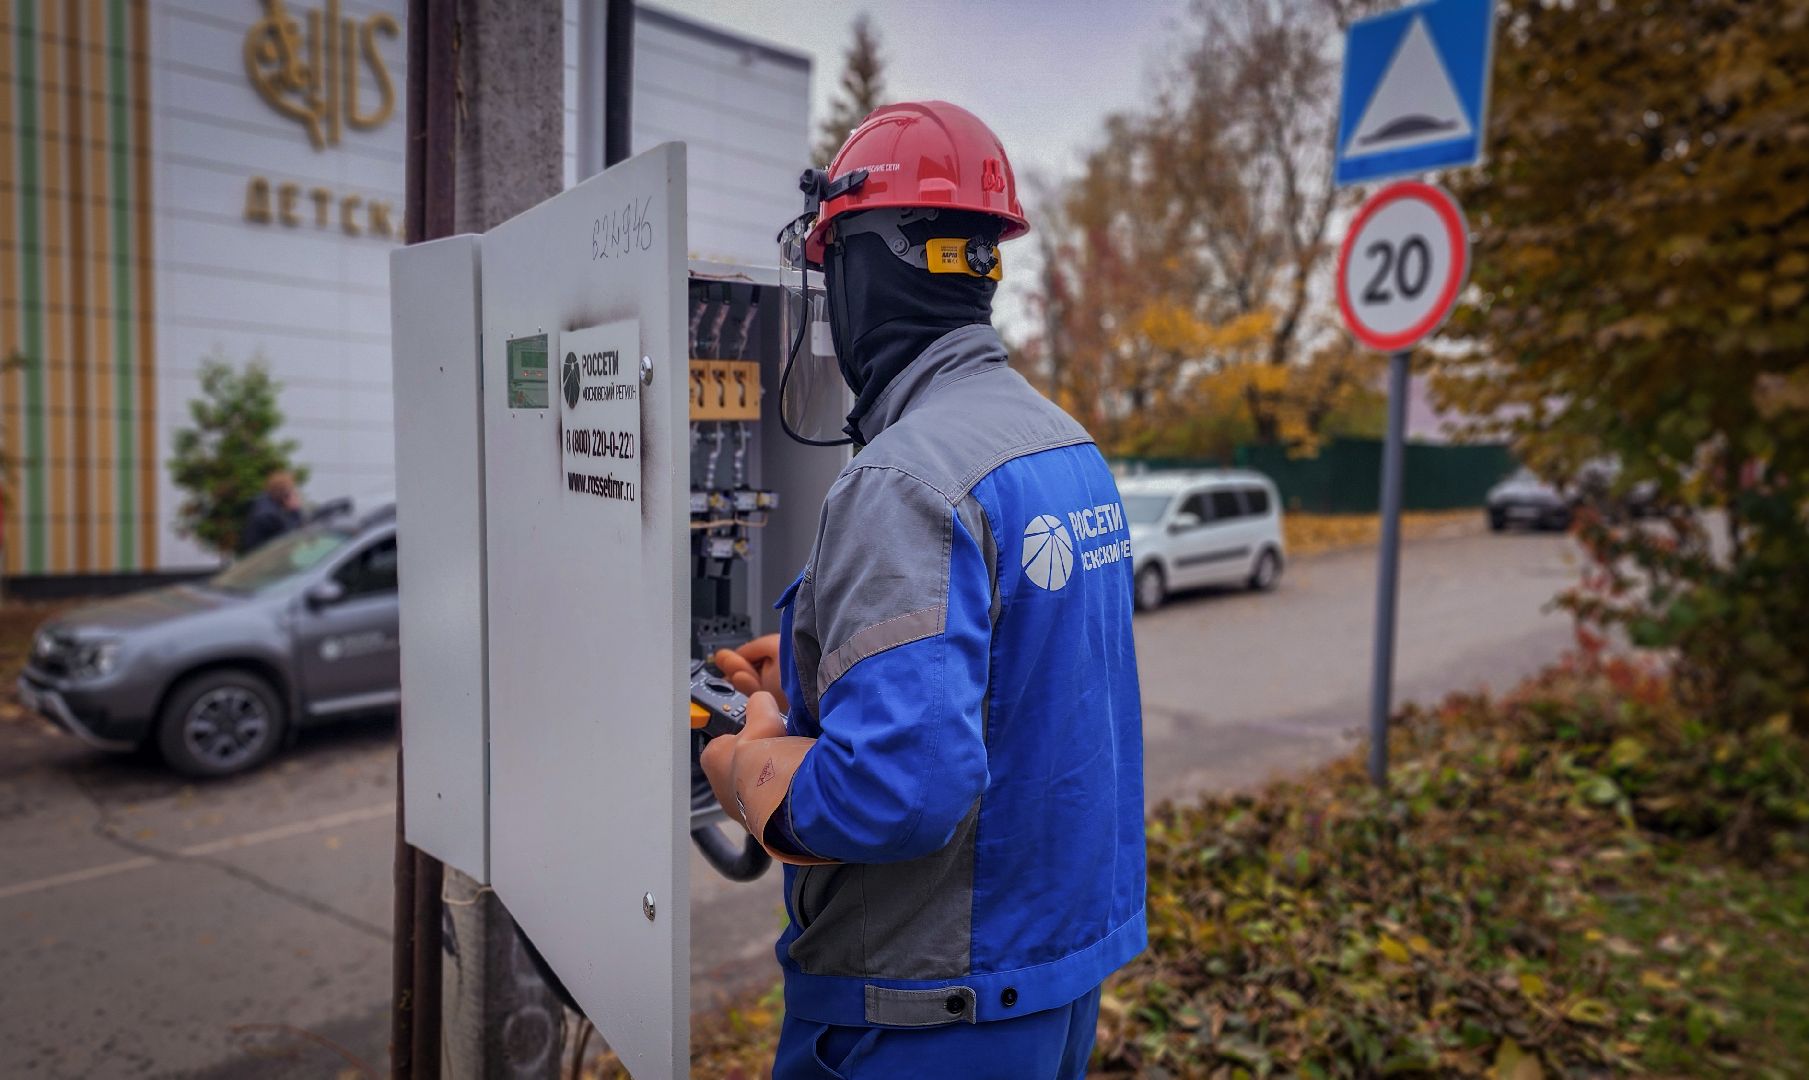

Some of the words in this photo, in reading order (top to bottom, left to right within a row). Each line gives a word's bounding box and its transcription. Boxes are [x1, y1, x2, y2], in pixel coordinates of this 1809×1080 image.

[1361, 234, 1433, 305] 20
[582, 350, 619, 377] РОССЕТИ
[566, 429, 571, 453] 8
[572, 429, 591, 458] (800)
[592, 429, 634, 459] 220-0-220
[568, 472, 635, 502] www.rossetimr.ru
